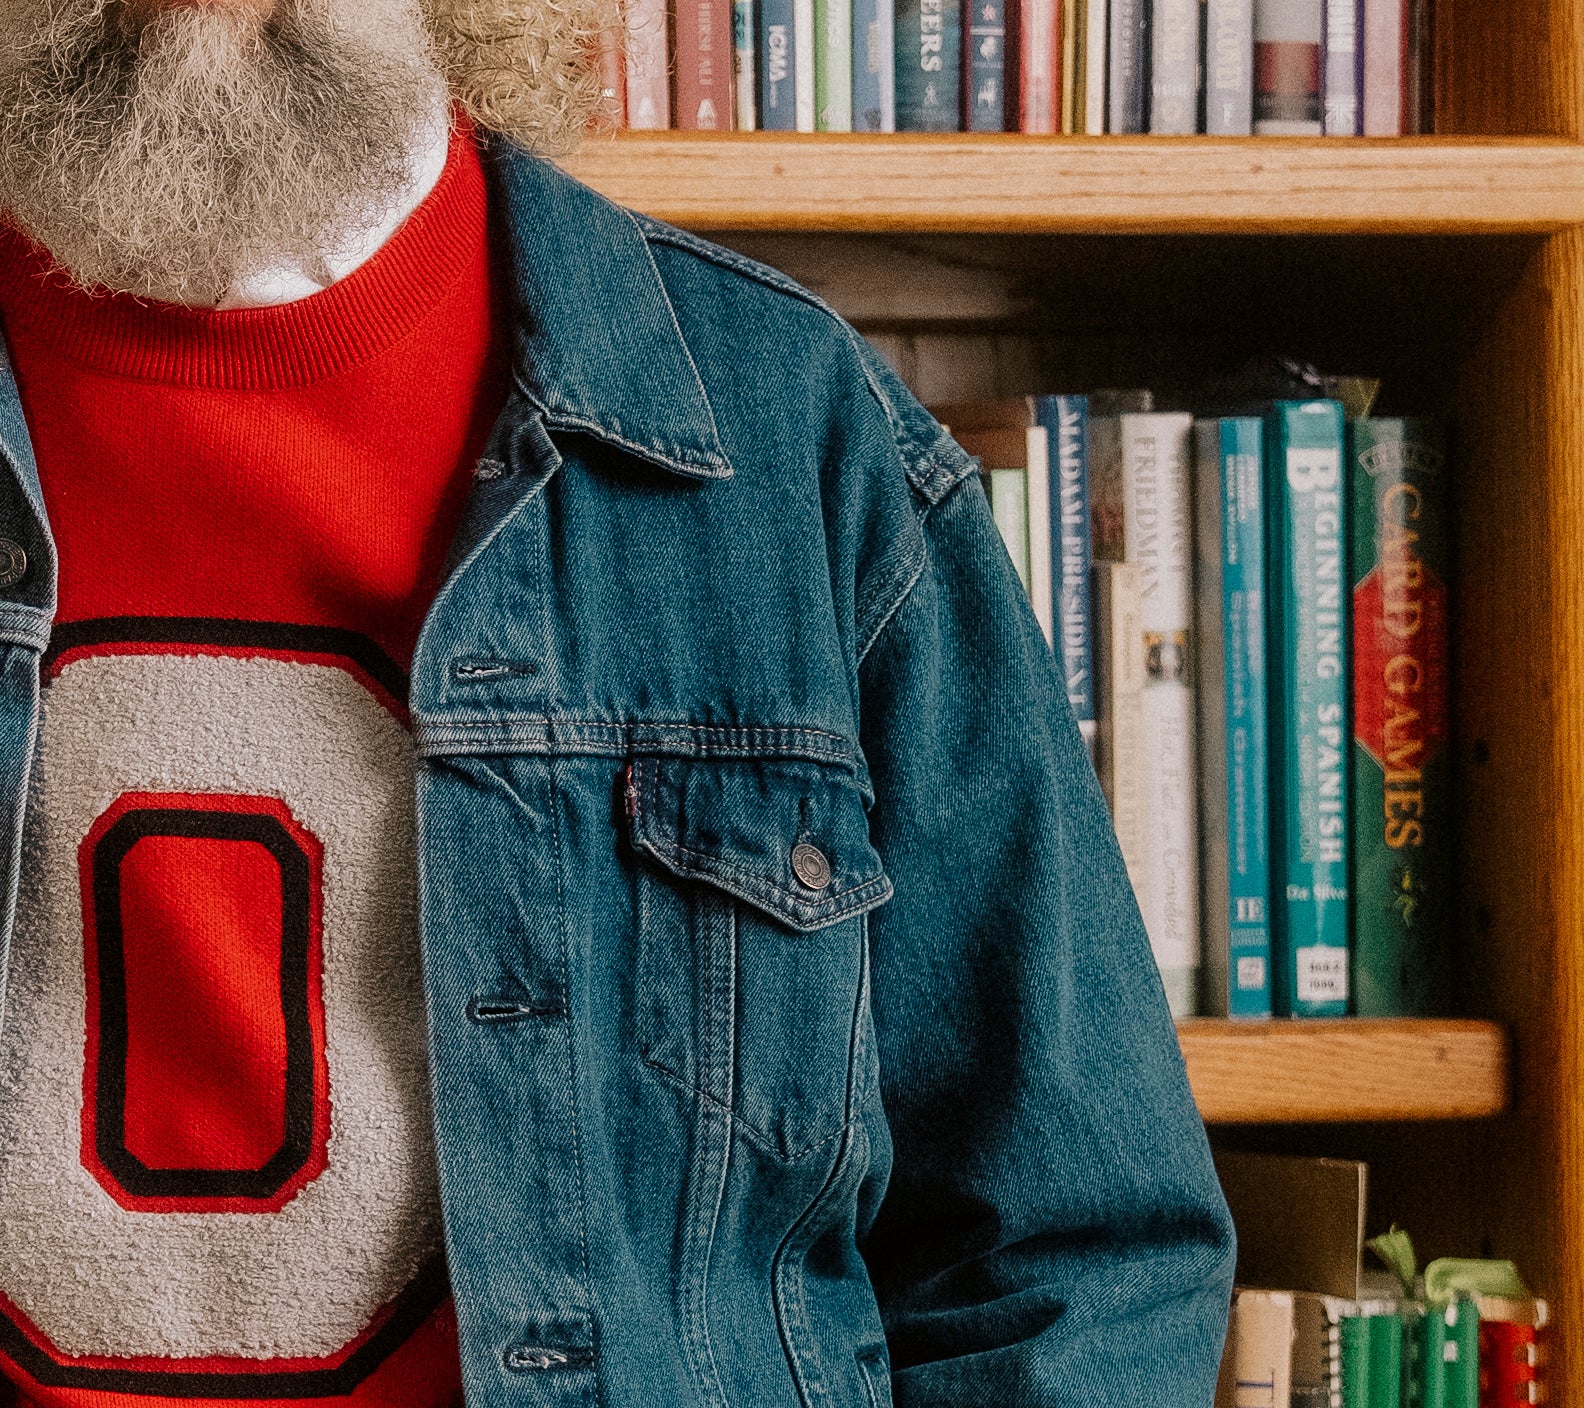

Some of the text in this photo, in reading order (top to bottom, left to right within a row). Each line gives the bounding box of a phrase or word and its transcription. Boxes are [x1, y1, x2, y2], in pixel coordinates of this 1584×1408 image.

[1287, 447, 1344, 864] BEGINNING SPANISH
[1383, 482, 1424, 850] CARD GAMES
